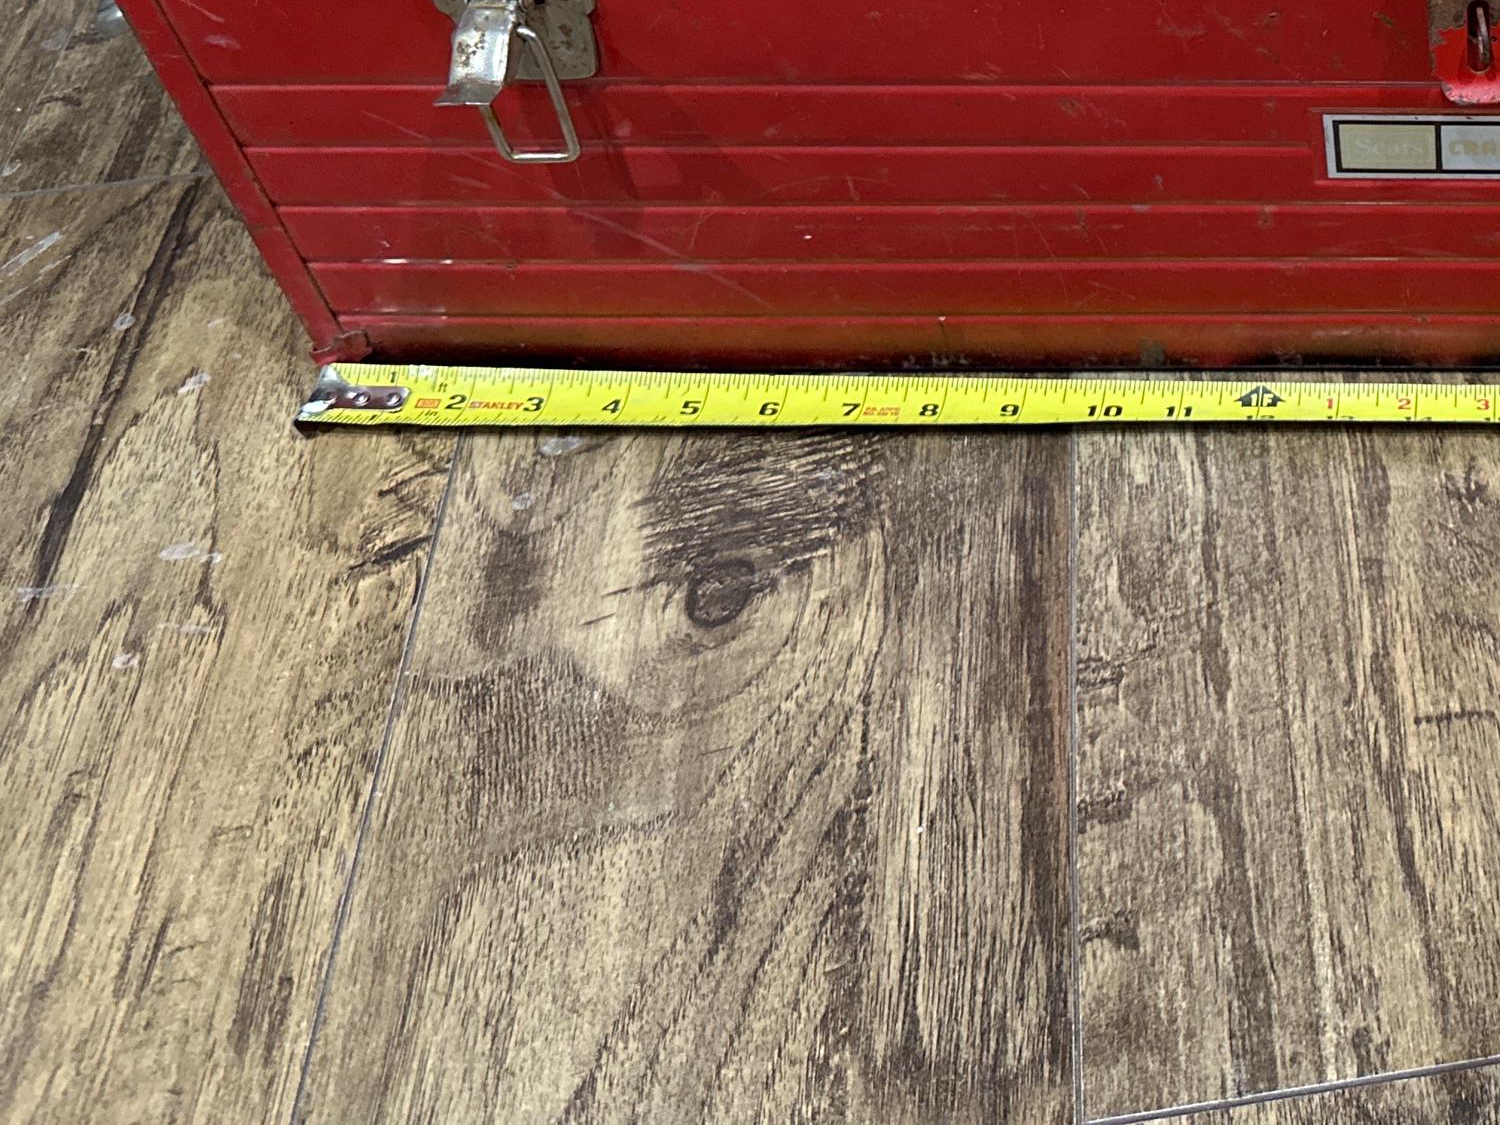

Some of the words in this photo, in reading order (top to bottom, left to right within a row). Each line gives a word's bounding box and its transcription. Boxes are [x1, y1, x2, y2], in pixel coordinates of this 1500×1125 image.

[1353, 135, 1425, 157] Sears
[389, 371, 397, 383] 1
[437, 382, 448, 393] ft
[445, 394, 467, 410] 2
[522, 397, 545, 413] 3
[601, 399, 622, 414] 4
[680, 400, 703, 415] 5
[759, 402, 780, 417] 6
[842, 402, 862, 417] 7
[918, 403, 940, 417] 8
[998, 403, 1020, 418] 9
[1086, 404, 1123, 418] 10
[1165, 405, 1194, 418] 11
[1326, 398, 1334, 410] 1
[1398, 398, 1412, 410] 2
[1476, 398, 1490, 411] 3
